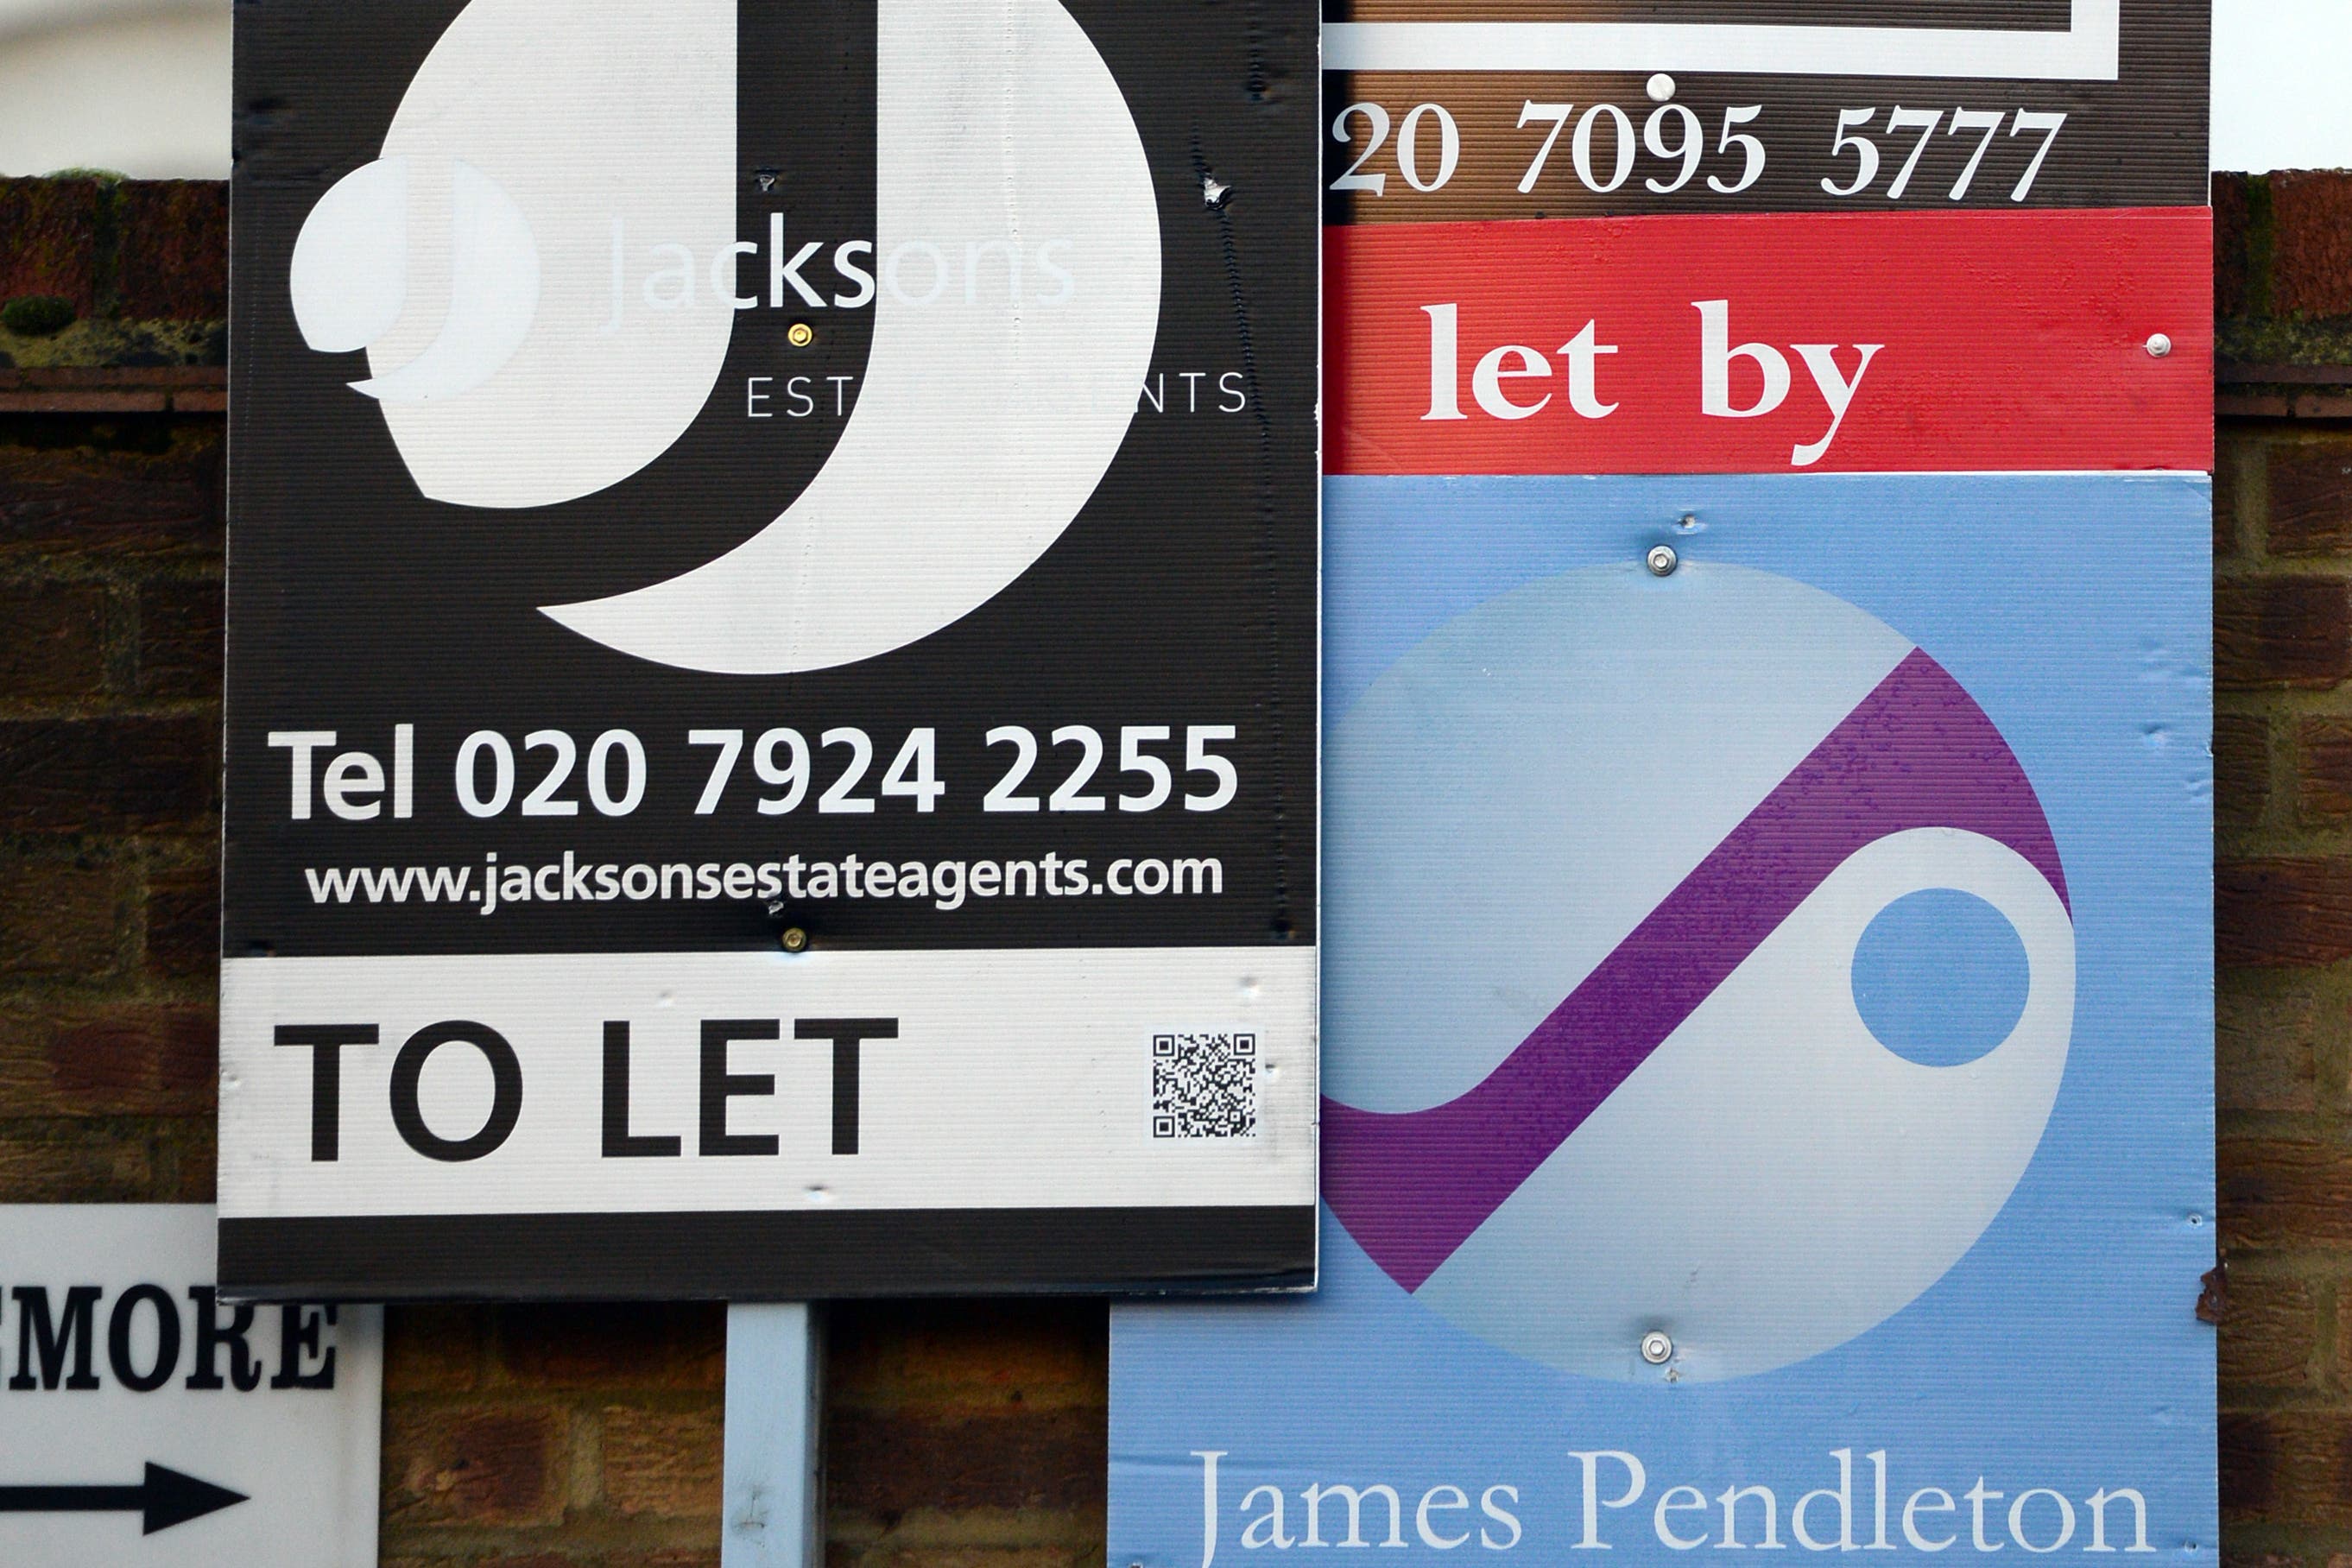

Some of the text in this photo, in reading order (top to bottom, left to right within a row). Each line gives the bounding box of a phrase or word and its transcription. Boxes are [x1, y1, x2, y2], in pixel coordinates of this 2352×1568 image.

[1515, 99, 1767, 194] 7095
[1819, 104, 2069, 203] 5777
[597, 212, 1077, 335] Jacksons
[1418, 299, 1887, 467] let by
[266, 723, 1239, 821] Tel 020 7924 2255
[304, 850, 1224, 915] www.jacksonsestateagents.com
[273, 1017, 900, 1163] TO LET
[0, 1282, 338, 1393] MORE
[1188, 1447, 2156, 1568] James Pendleton
